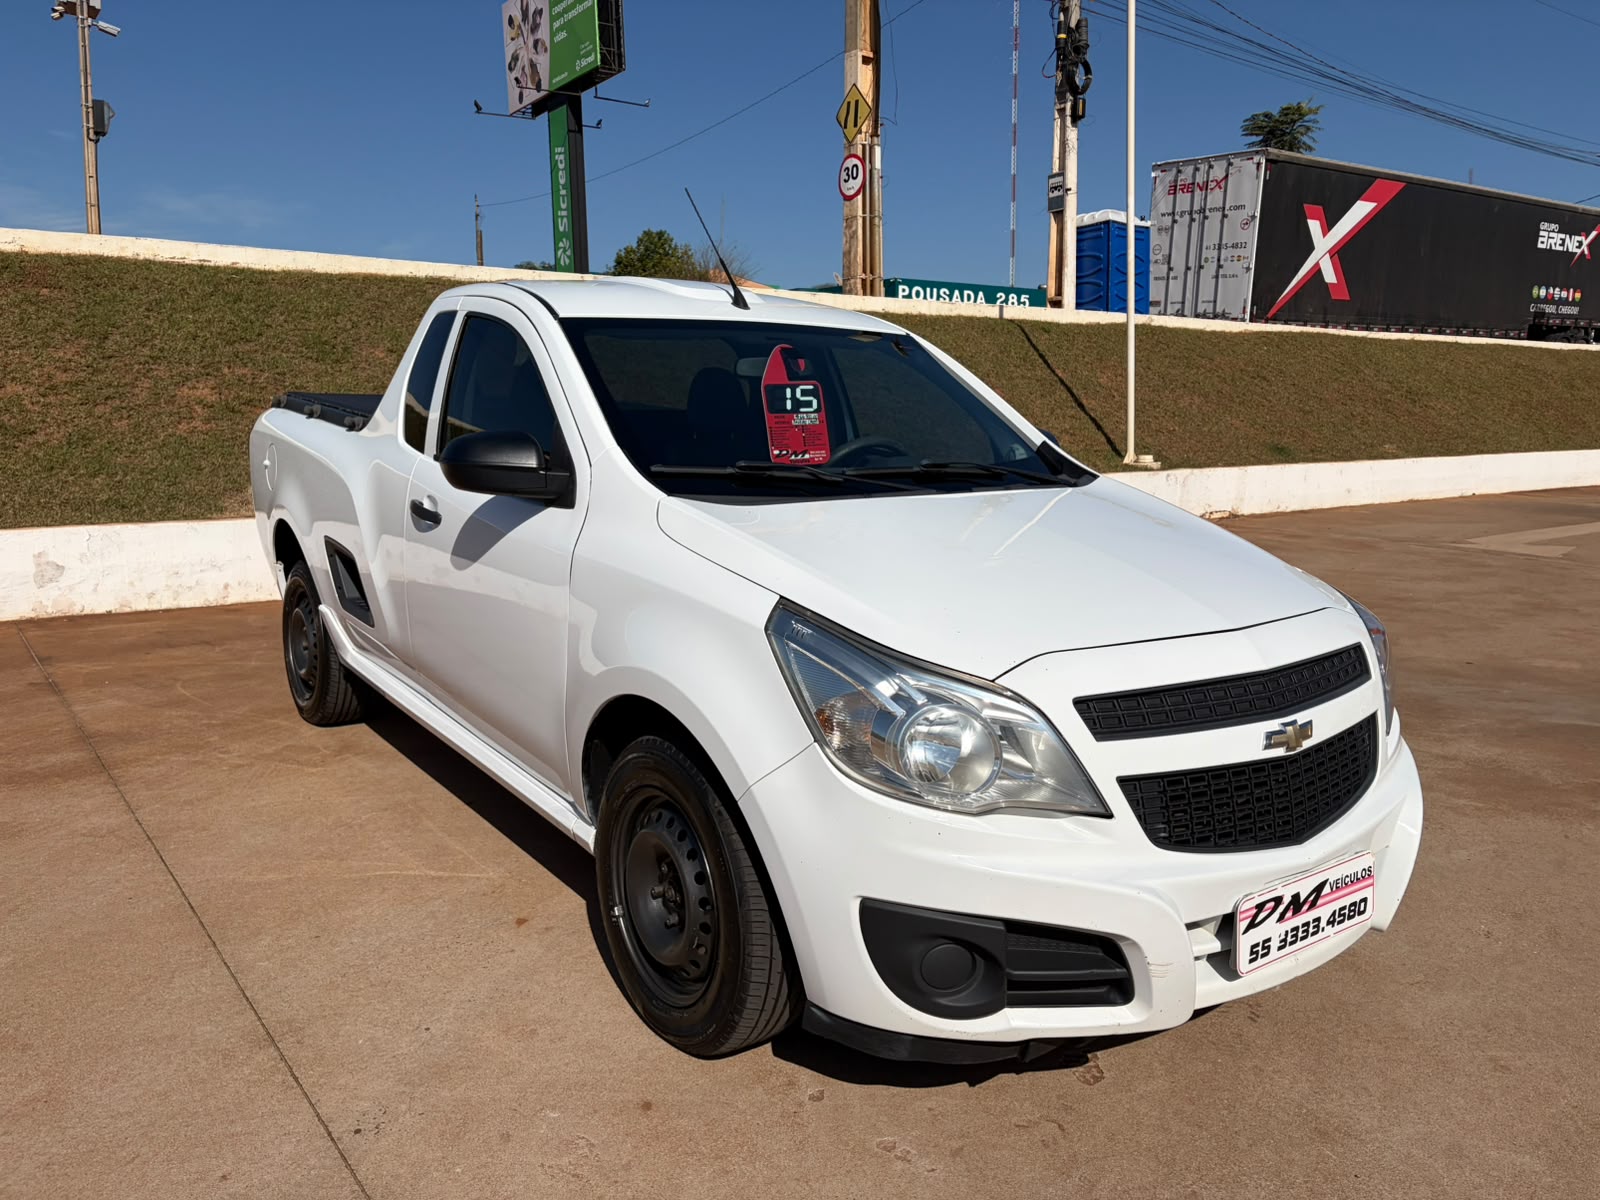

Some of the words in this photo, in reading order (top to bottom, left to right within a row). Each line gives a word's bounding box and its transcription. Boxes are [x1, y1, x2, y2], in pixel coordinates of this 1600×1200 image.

[553, 17, 564, 32] para
[843, 163, 859, 183] 30
[554, 146, 569, 232] Sicredi
[1539, 221, 1560, 232] GRUPO
[1537, 224, 1600, 267] BRENEX
[898, 285, 986, 304] POUSADA
[996, 292, 1030, 307] 285
[785, 385, 818, 412] 15
[1242, 878, 1330, 935] DM
[1329, 866, 1372, 892] VEÍCULOS
[1248, 936, 1272, 965] 55
[1277, 897, 1368, 952] 3333.4580
